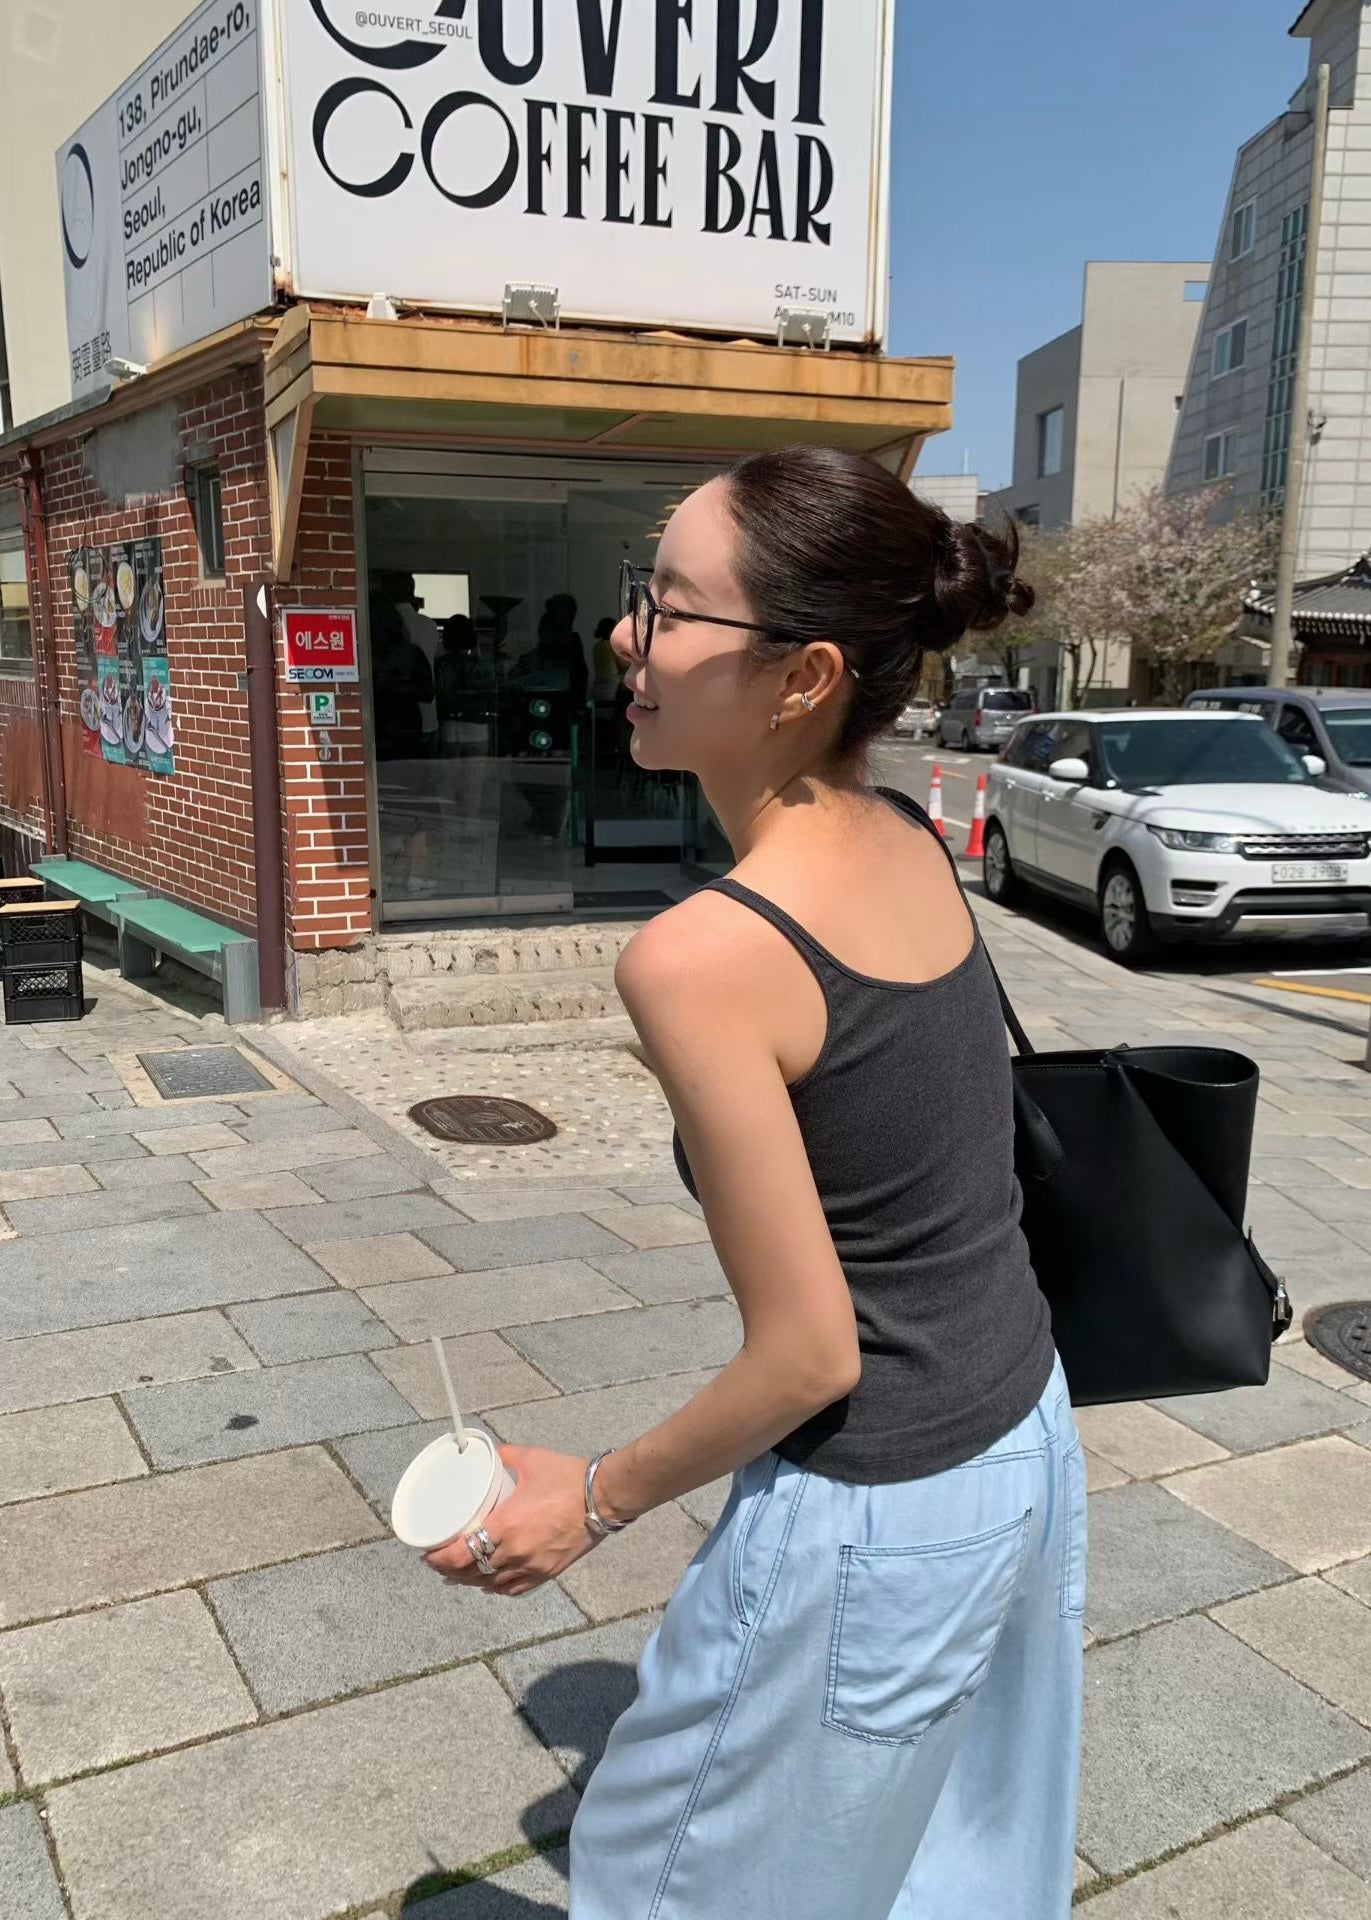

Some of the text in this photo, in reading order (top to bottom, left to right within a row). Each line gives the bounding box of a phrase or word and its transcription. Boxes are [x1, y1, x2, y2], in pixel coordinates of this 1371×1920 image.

[355, 11, 473, 40] @OUVERT_SEOUL
[118, 2, 250, 138] 138, Pirundae-ro,
[121, 105, 201, 190] Jongno-gu,
[312, 76, 834, 246] COFFEE BAR
[124, 186, 166, 240] Seoul,
[127, 179, 262, 291] Republic of Korea
[774, 284, 838, 303] SAT-SUN
[295, 631, 345, 651] 에스원
[289, 668, 334, 680] SECOM
[314, 694, 330, 712] P
